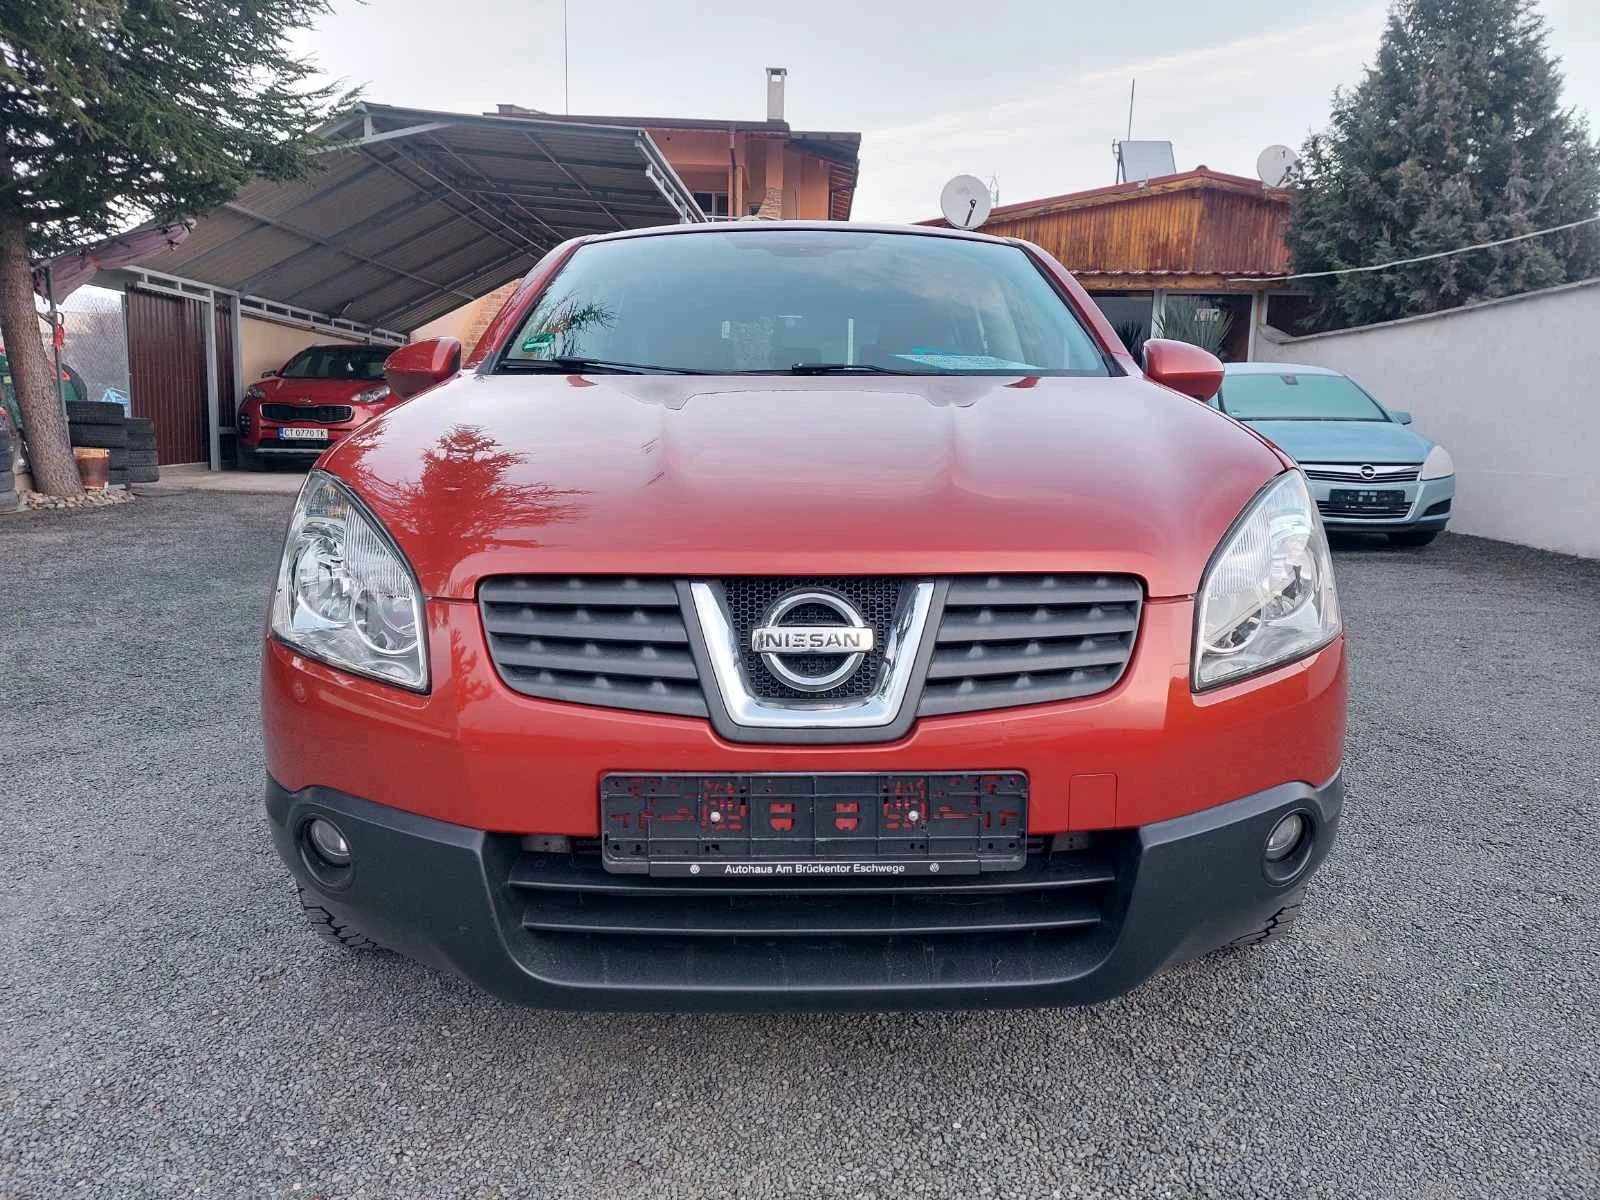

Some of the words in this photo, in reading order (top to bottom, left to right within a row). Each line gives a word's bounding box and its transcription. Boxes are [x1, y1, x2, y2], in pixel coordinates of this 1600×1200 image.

[763, 632, 861, 648] NISSAN
[724, 864, 773, 874] Autohaus
[775, 864, 793, 874] Am
[795, 863, 851, 874] Brückentor
[853, 863, 905, 874] Eschwege
